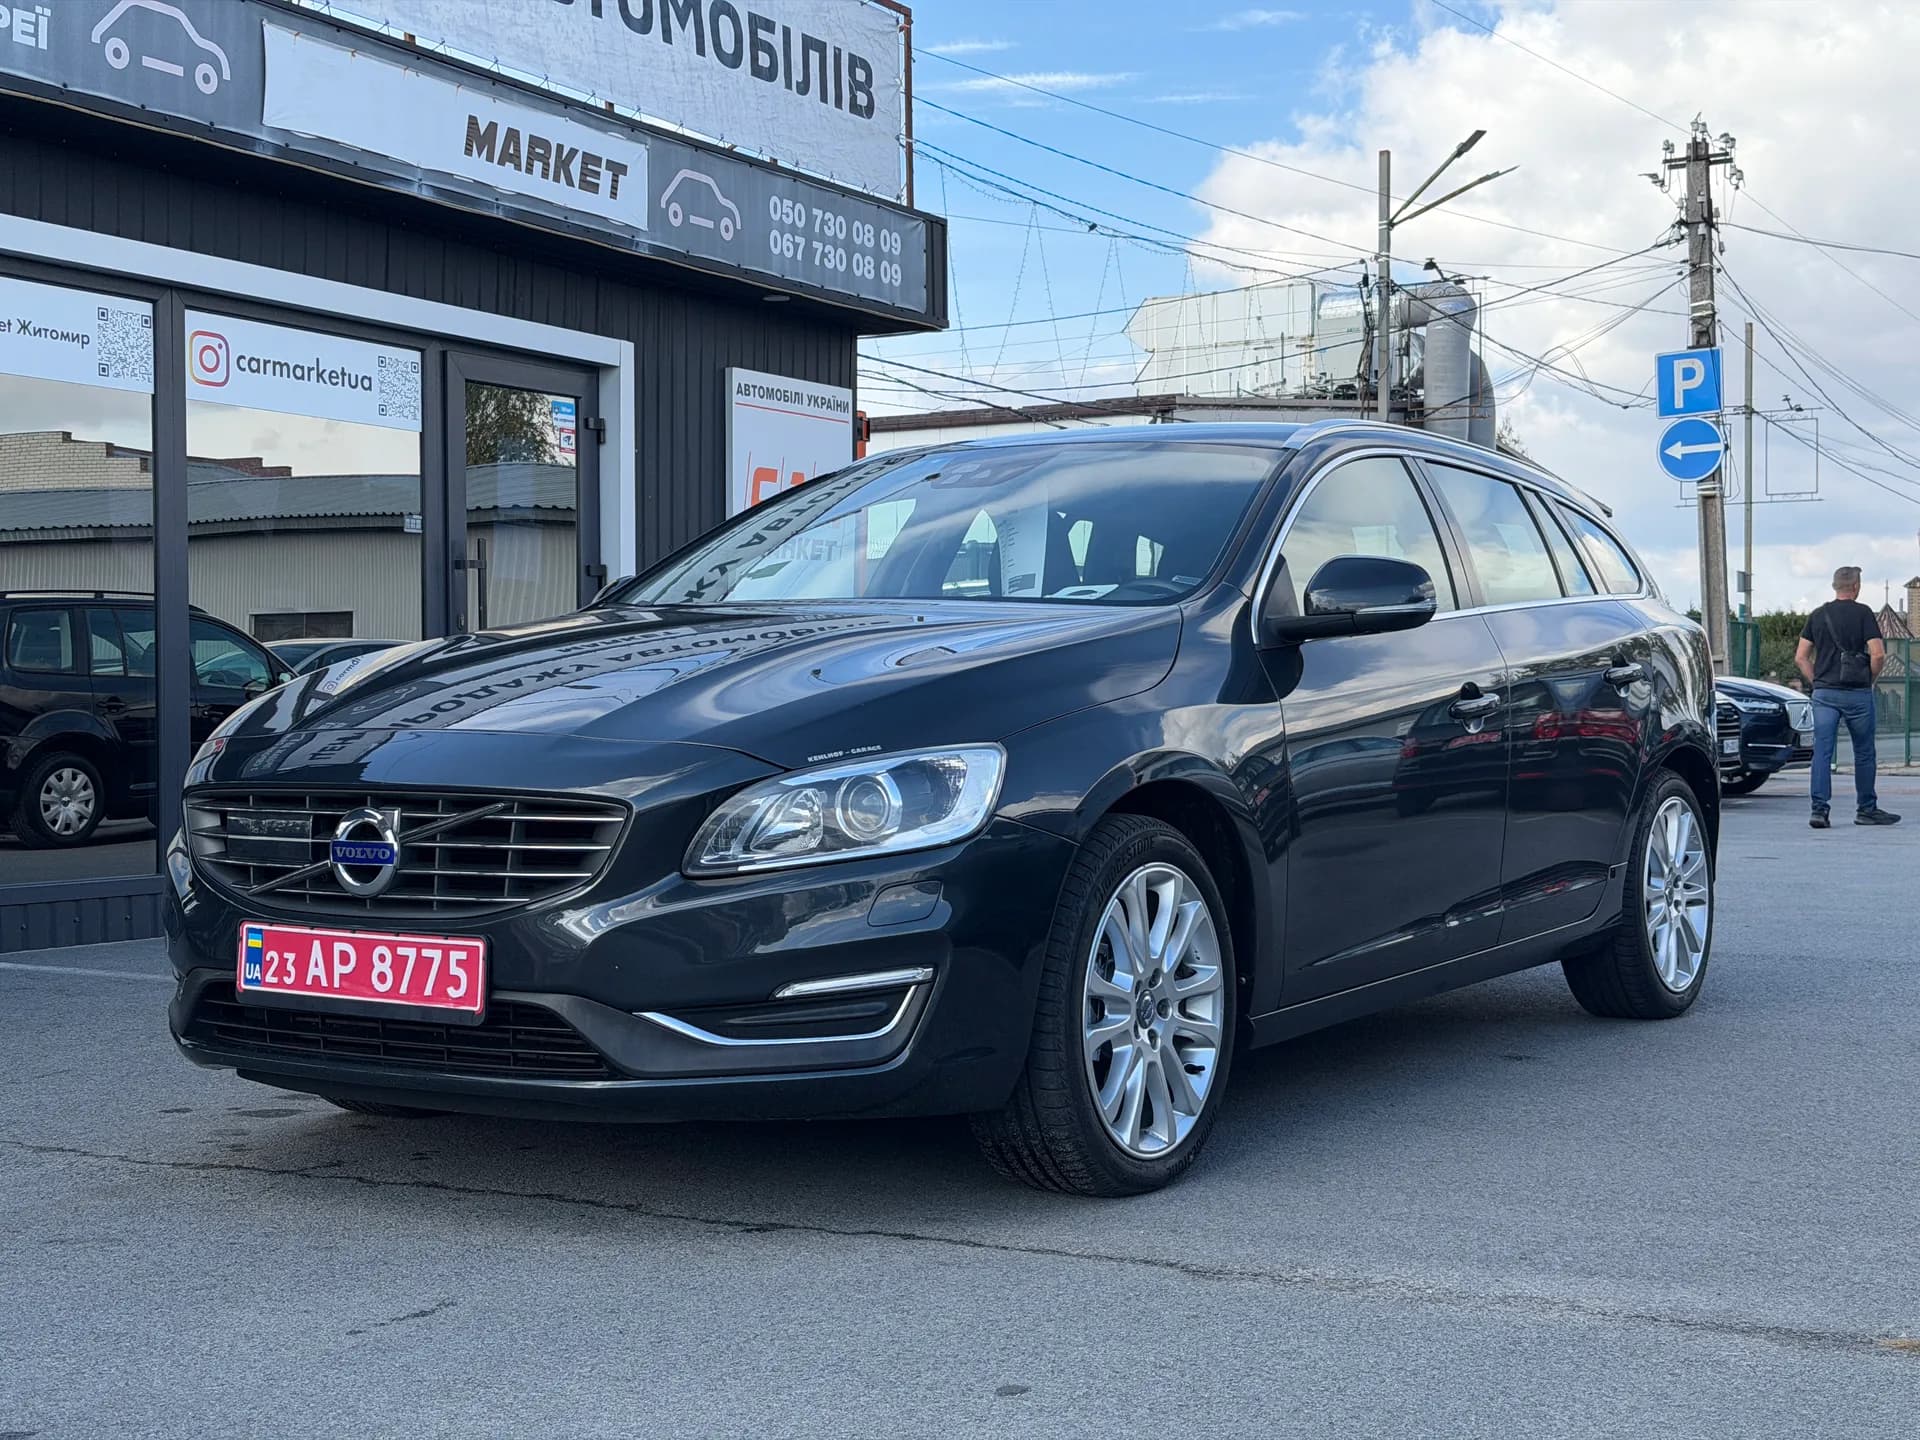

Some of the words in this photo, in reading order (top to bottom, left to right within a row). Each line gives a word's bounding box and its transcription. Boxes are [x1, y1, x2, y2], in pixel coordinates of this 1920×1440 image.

[555, 0, 874, 119] ОМОБІЛІВ
[464, 115, 628, 200] MARKET
[769, 195, 806, 228] 050
[812, 208, 847, 240] 730
[852, 220, 875, 248] 08
[880, 229, 901, 255] 09
[769, 229, 806, 261] 067
[812, 241, 847, 272] 730
[852, 253, 875, 280] 08
[880, 260, 901, 287] 09
[17, 318, 90, 349] Житомир
[236, 354, 372, 392] carmarketua
[736, 382, 804, 406] АВТОМОБІЛІ
[807, 394, 849, 414] УКРАЇНИ
[1673, 358, 1705, 409] P
[334, 846, 391, 860] VOLVO
[246, 962, 262, 981] UA
[265, 950, 297, 984] 23
[371, 945, 468, 998] 8775
